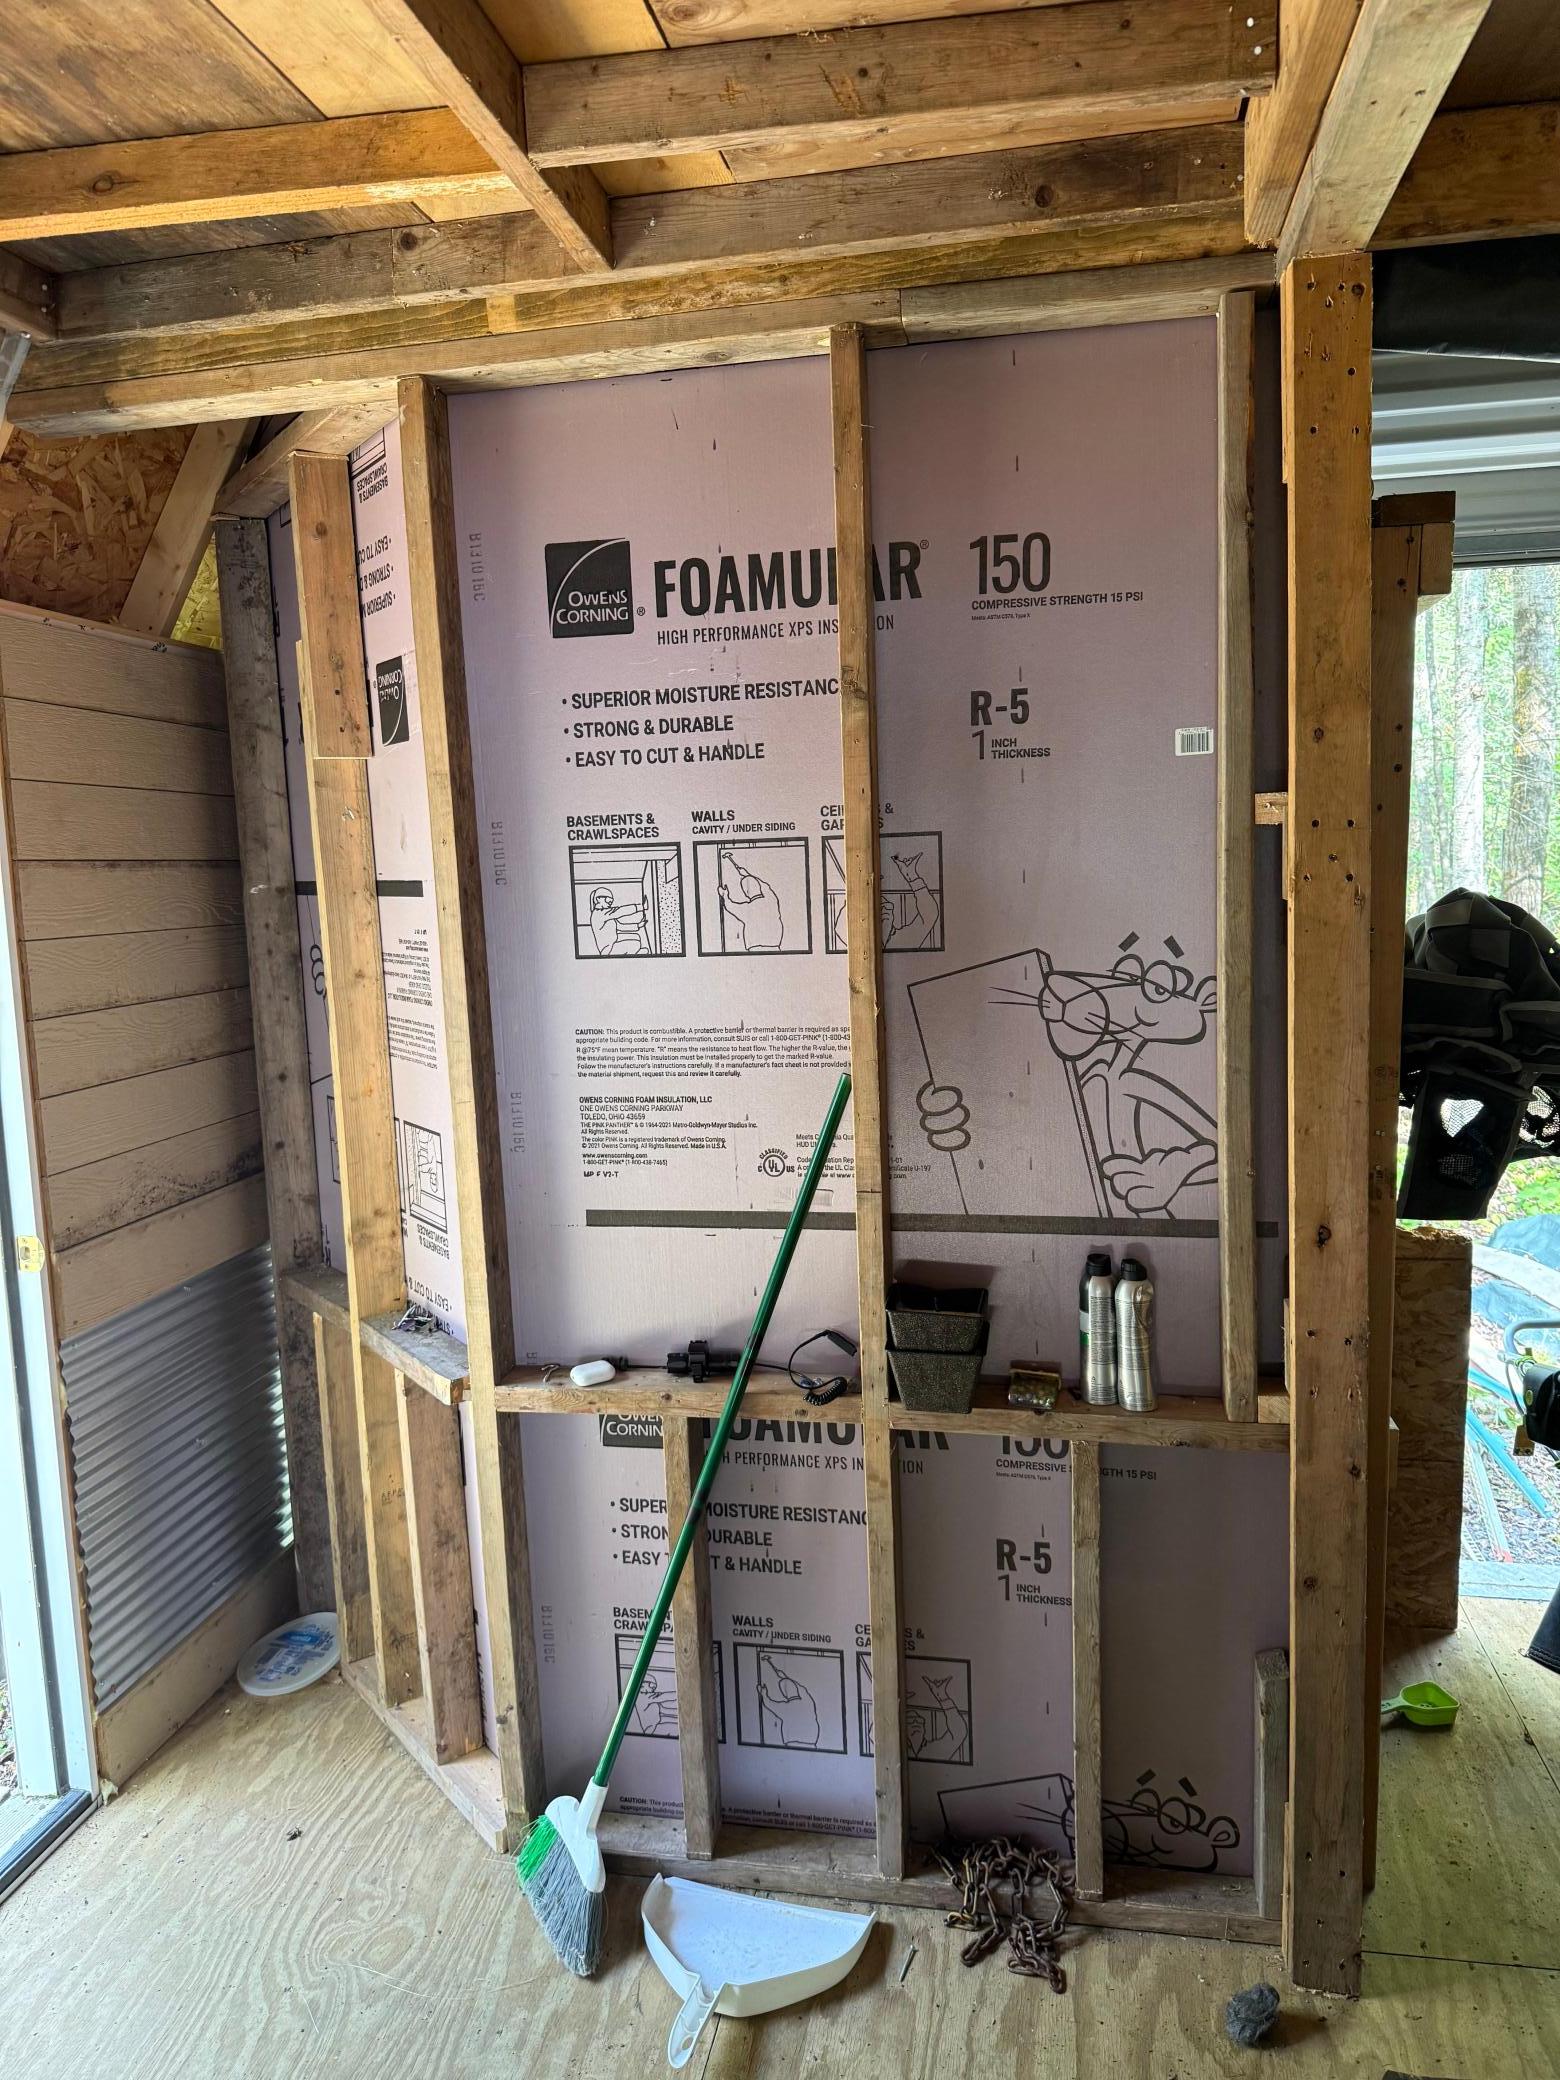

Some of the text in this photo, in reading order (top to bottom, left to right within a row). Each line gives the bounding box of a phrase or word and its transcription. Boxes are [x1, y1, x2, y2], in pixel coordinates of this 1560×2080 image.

[969, 532, 1051, 594] 150
[568, 589, 628, 607] OWENS
[972, 592, 1143, 610] COMPRESSIVE STRENGTH 15 PSI
[556, 607, 629, 625] CORNING
[657, 629, 689, 645] HIGH
[693, 623, 784, 643] PERFORMANCE
[789, 621, 814, 637] XPS
[571, 679, 839, 709] SUPERIOR MOISTURE RESISTANC
[970, 688, 1030, 726] R-5
[573, 715, 734, 738] STRONG & DURABLE
[972, 730, 984, 760] 1
[991, 738, 1017, 749] INCH
[575, 743, 765, 768] EASY TO CUT & HANDLE
[991, 747, 1051, 759] THICKNESS
[567, 813, 655, 828] BASEMENTS &
[692, 810, 735, 822] WALLS
[567, 827, 659, 841] CRAWLSPACES
[692, 825, 724, 835] CAVITY
[733, 823, 762, 833] UNDER
[765, 822, 796, 832] SIDING
[656, 1096, 698, 1104] INSULATION,
[759, 1147, 788, 1160] CLASSIFIED
[606, 1421, 663, 1437] CORNIN
[735, 1452, 820, 1469] PERFORMANCE
[825, 1455, 848, 1470] XPS
[996, 1459, 1067, 1473] COMPRESSIVE
[1126, 1470, 1138, 1479] 15
[1140, 1470, 1157, 1481] PSI
[622, 1550, 661, 1566] EASY
[725, 1555, 735, 1571] &
[739, 1556, 803, 1575] HANDLE
[996, 1538, 1052, 1575] R-5
[998, 1574, 1011, 1602] 1
[1016, 1583, 1041, 1595] INCH
[1016, 1593, 1073, 1606] THICKNESS
[732, 1614, 774, 1628] WALLS
[732, 1628, 763, 1639] CAVITY
[771, 1630, 801, 1643] UNDER
[803, 1632, 832, 1644] SIDING
